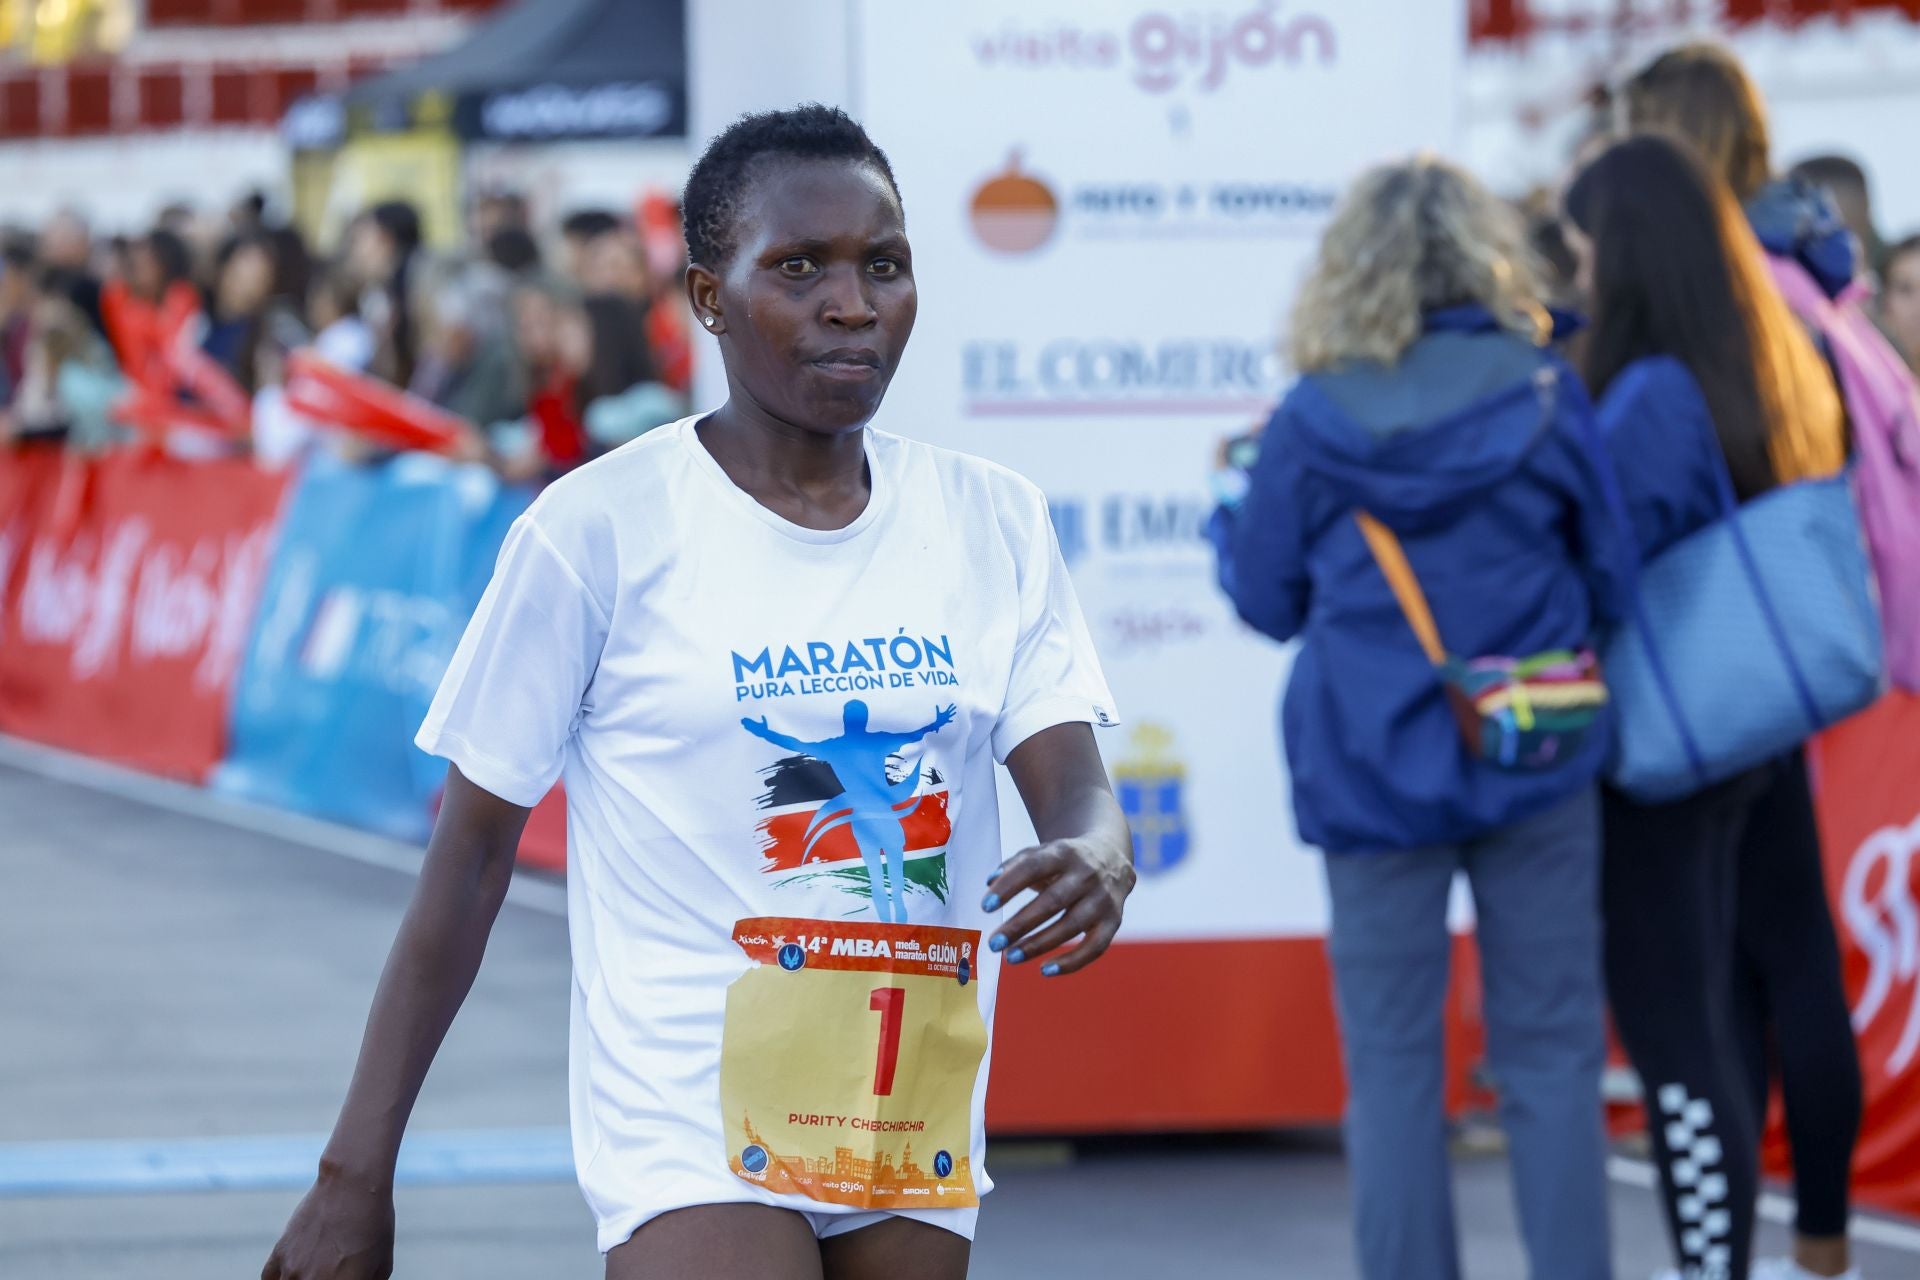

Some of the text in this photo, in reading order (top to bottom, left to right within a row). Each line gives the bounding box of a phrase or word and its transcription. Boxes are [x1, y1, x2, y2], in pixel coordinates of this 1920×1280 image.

[1130, 0, 1337, 93] gijón
[962, 341, 1284, 391] EL COMERC
[731, 627, 954, 683] MARATÓN
[736, 671, 959, 702] PURA LECCIÓN DE VIDA
[830, 937, 892, 958] MBA
[895, 940, 920, 950] media
[895, 950, 927, 962] maratón
[928, 942, 957, 964] GIJÓN
[869, 986, 905, 1096] 1
[788, 1113, 925, 1132] PURITY CHERCHIRCHIR
[840, 1181, 864, 1193] gijón
